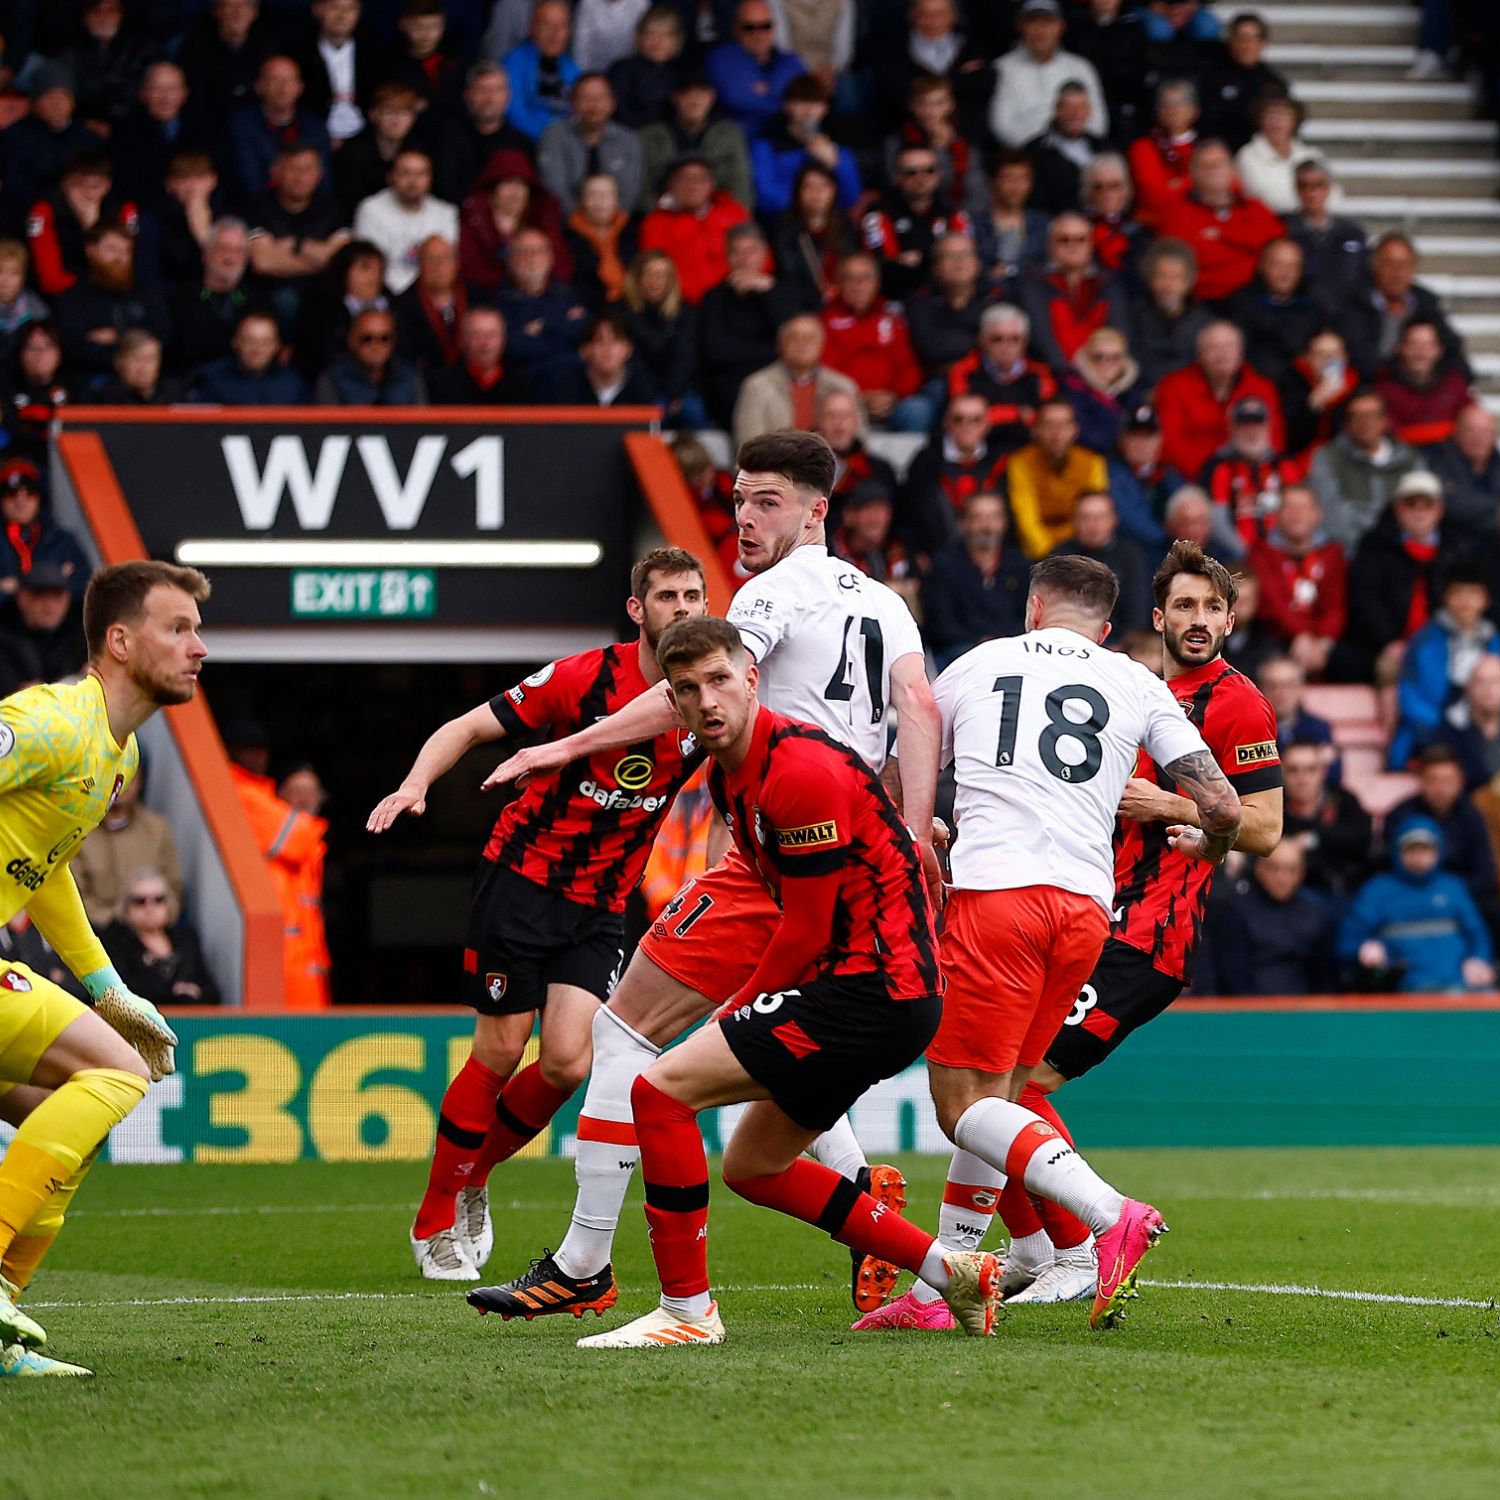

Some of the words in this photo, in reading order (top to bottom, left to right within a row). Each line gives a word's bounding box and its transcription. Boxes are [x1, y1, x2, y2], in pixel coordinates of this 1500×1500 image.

[220, 434, 505, 530] WV1
[293, 572, 377, 612] EXIT
[824, 615, 884, 725] 41
[1023, 641, 1090, 660] INGS
[992, 675, 1111, 784] 18
[662, 878, 715, 937] 41
